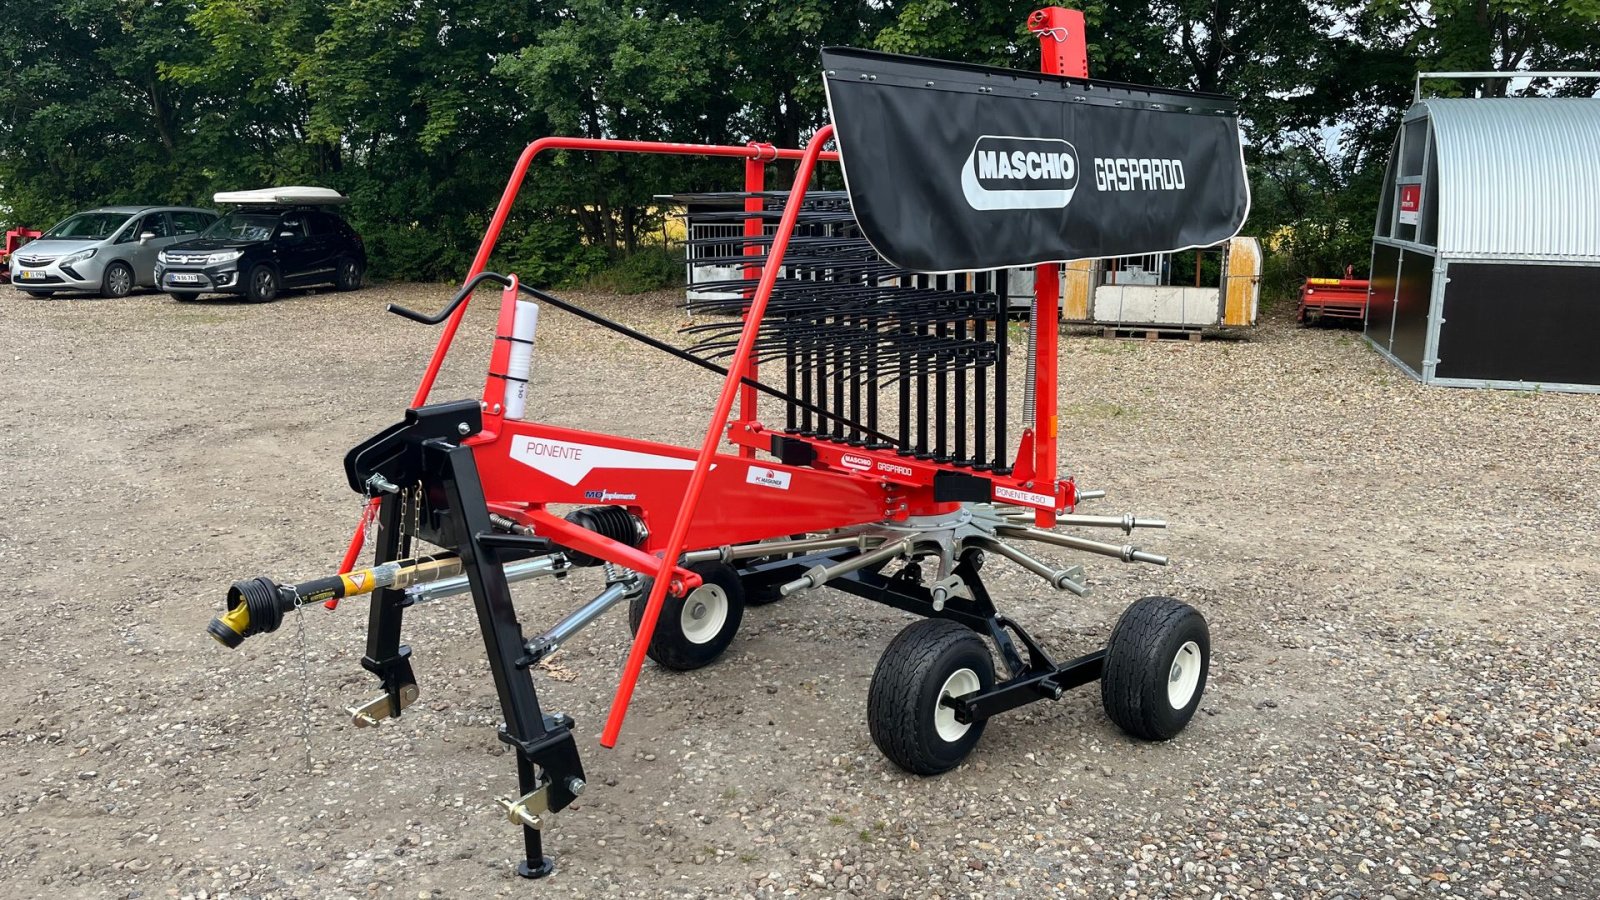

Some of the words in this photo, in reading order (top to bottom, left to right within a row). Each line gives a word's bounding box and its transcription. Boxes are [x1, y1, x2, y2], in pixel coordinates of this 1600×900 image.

[978, 150, 1075, 180] MASCHIO
[1094, 157, 1186, 191] GASPARDO
[526, 441, 582, 461] PONENTE
[844, 455, 872, 467] MASCHIO
[877, 462, 912, 476] GASPARDO
[996, 487, 1029, 501] PONENTE
[1030, 494, 1046, 504] 450
